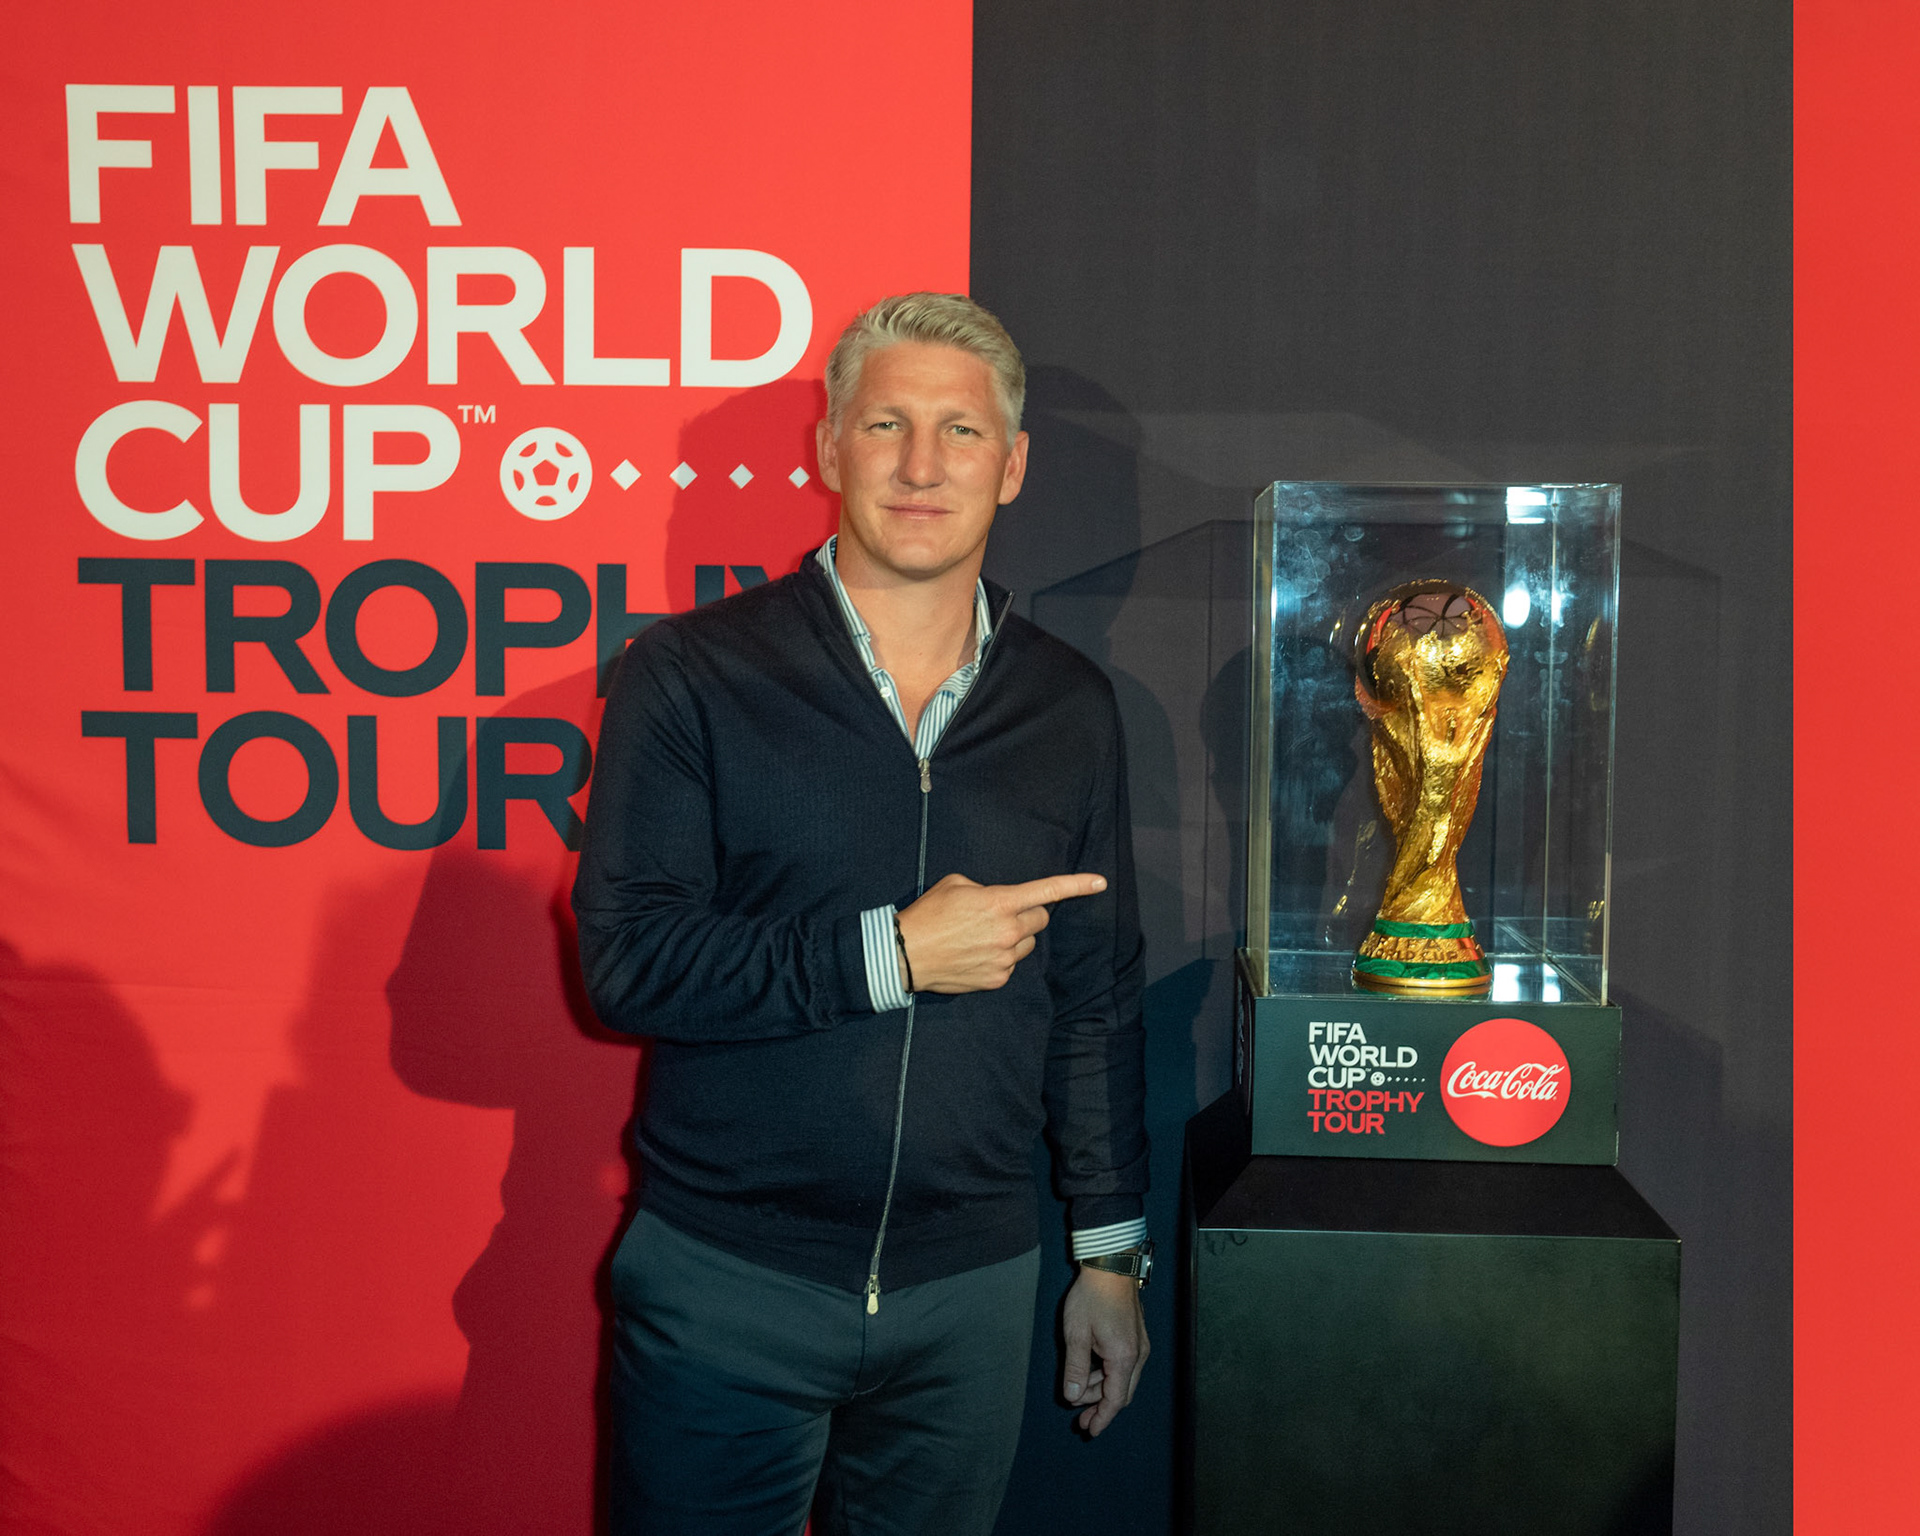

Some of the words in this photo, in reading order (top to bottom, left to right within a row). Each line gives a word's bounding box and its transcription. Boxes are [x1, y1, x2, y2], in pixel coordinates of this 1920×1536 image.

[66, 84, 462, 226] FIFA
[72, 244, 813, 388] WORLD
[75, 400, 462, 542] CUP
[77, 557, 770, 699] TROPH
[81, 710, 593, 852] TOUR
[1308, 1021, 1367, 1044] FIFA
[1309, 1044, 1418, 1068] WORLD
[1307, 1066, 1366, 1089] CUP
[1447, 1061, 1565, 1100] Coca-Cola
[1307, 1089, 1425, 1113] TROPHY
[1307, 1111, 1385, 1134] TOUR
